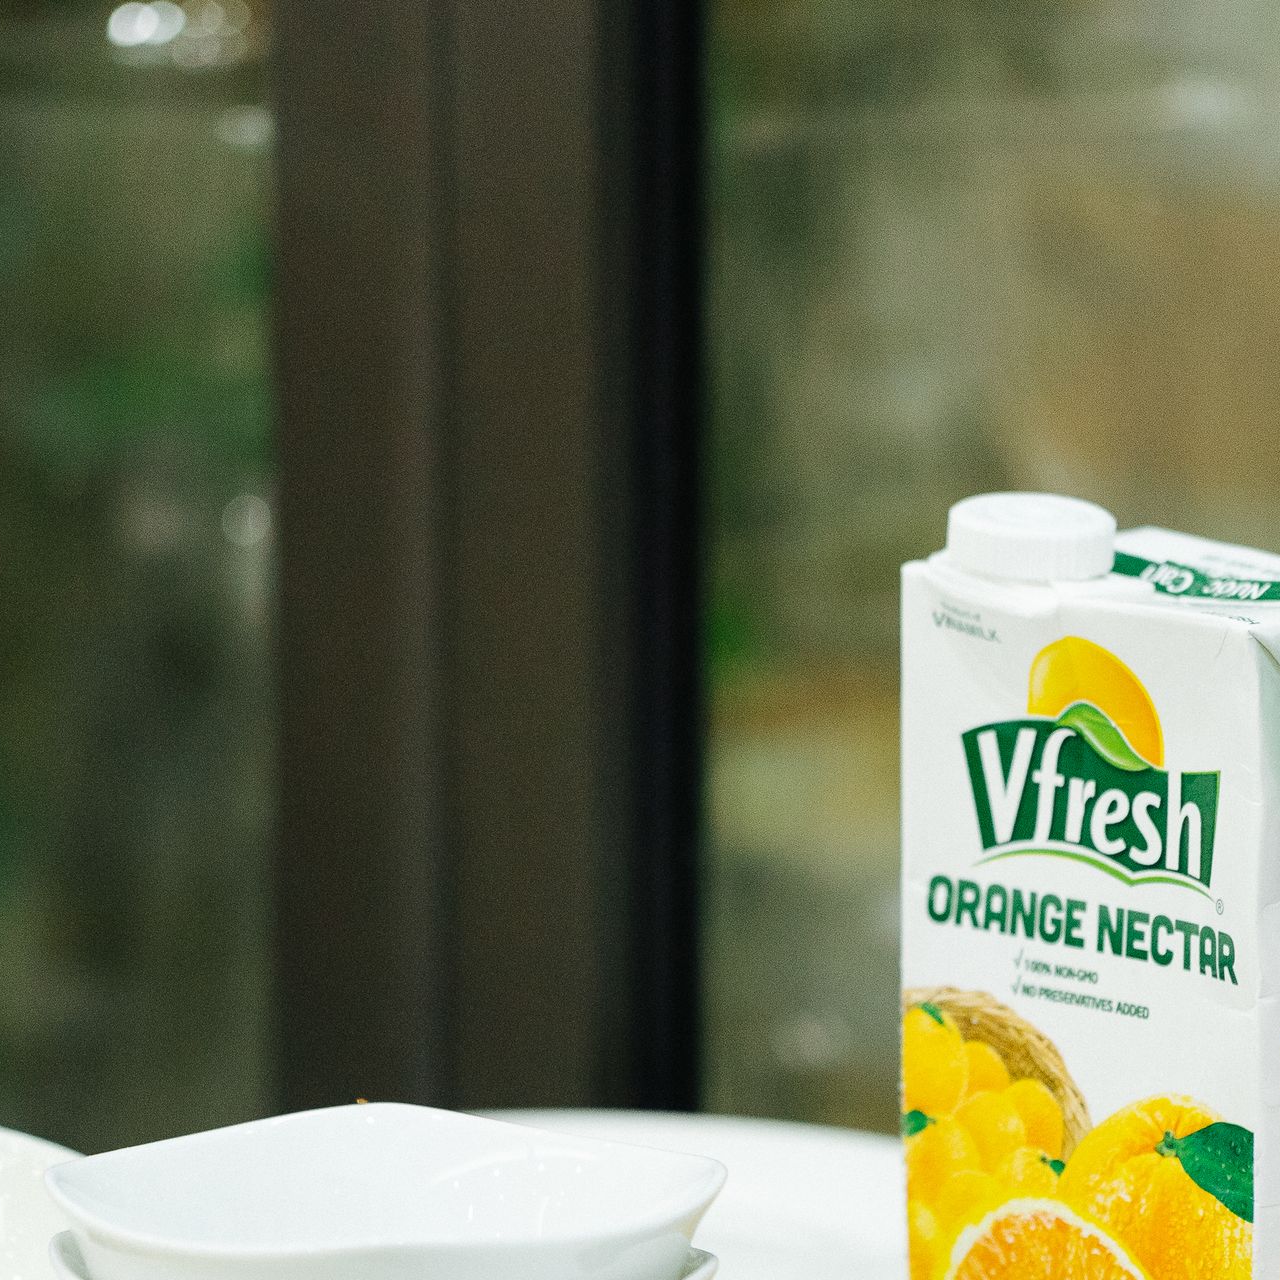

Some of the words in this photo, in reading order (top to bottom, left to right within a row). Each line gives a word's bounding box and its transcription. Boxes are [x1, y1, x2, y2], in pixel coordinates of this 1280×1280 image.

[977, 728, 1203, 880] Vfresh
[927, 875, 1087, 949] ORANGE
[1096, 904, 1238, 986] NECTAR
[1022, 984, 1036, 998] NO
[1038, 986, 1113, 1013] PRESERVATIVES
[1116, 1001, 1150, 1020] ADDED
[1025, 960, 1052, 976] 100%
[1054, 964, 1098, 985] NON-GMO
